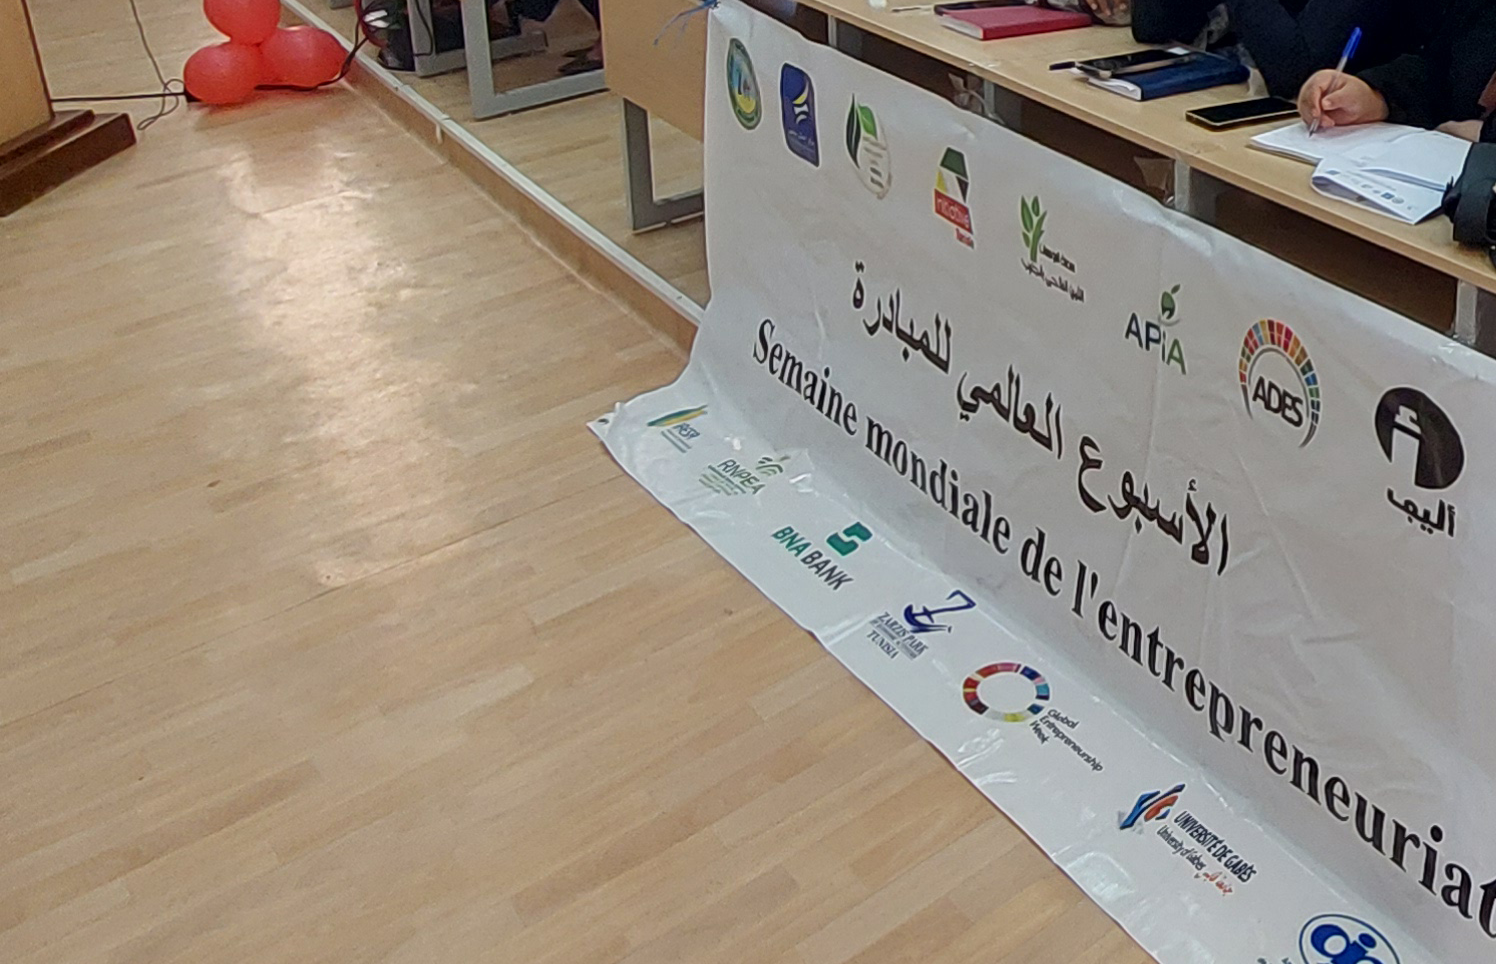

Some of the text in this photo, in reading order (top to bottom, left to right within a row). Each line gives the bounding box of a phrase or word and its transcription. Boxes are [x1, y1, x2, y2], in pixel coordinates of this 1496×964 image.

[852, 260, 1228, 576] الأسبوع العالمي للمبادرة
[1252, 376, 1303, 428] ADES
[752, 318, 857, 437] Semaine
[865, 416, 1011, 555] mondiale
[1020, 526, 1063, 596] de
[771, 525, 854, 592] BNA BANK
[1039, 715, 1104, 771] Entrepreneurship
[1047, 709, 1080, 729] Global
[1173, 810, 1258, 883] UNIVERSITÉ DE GABÈS
